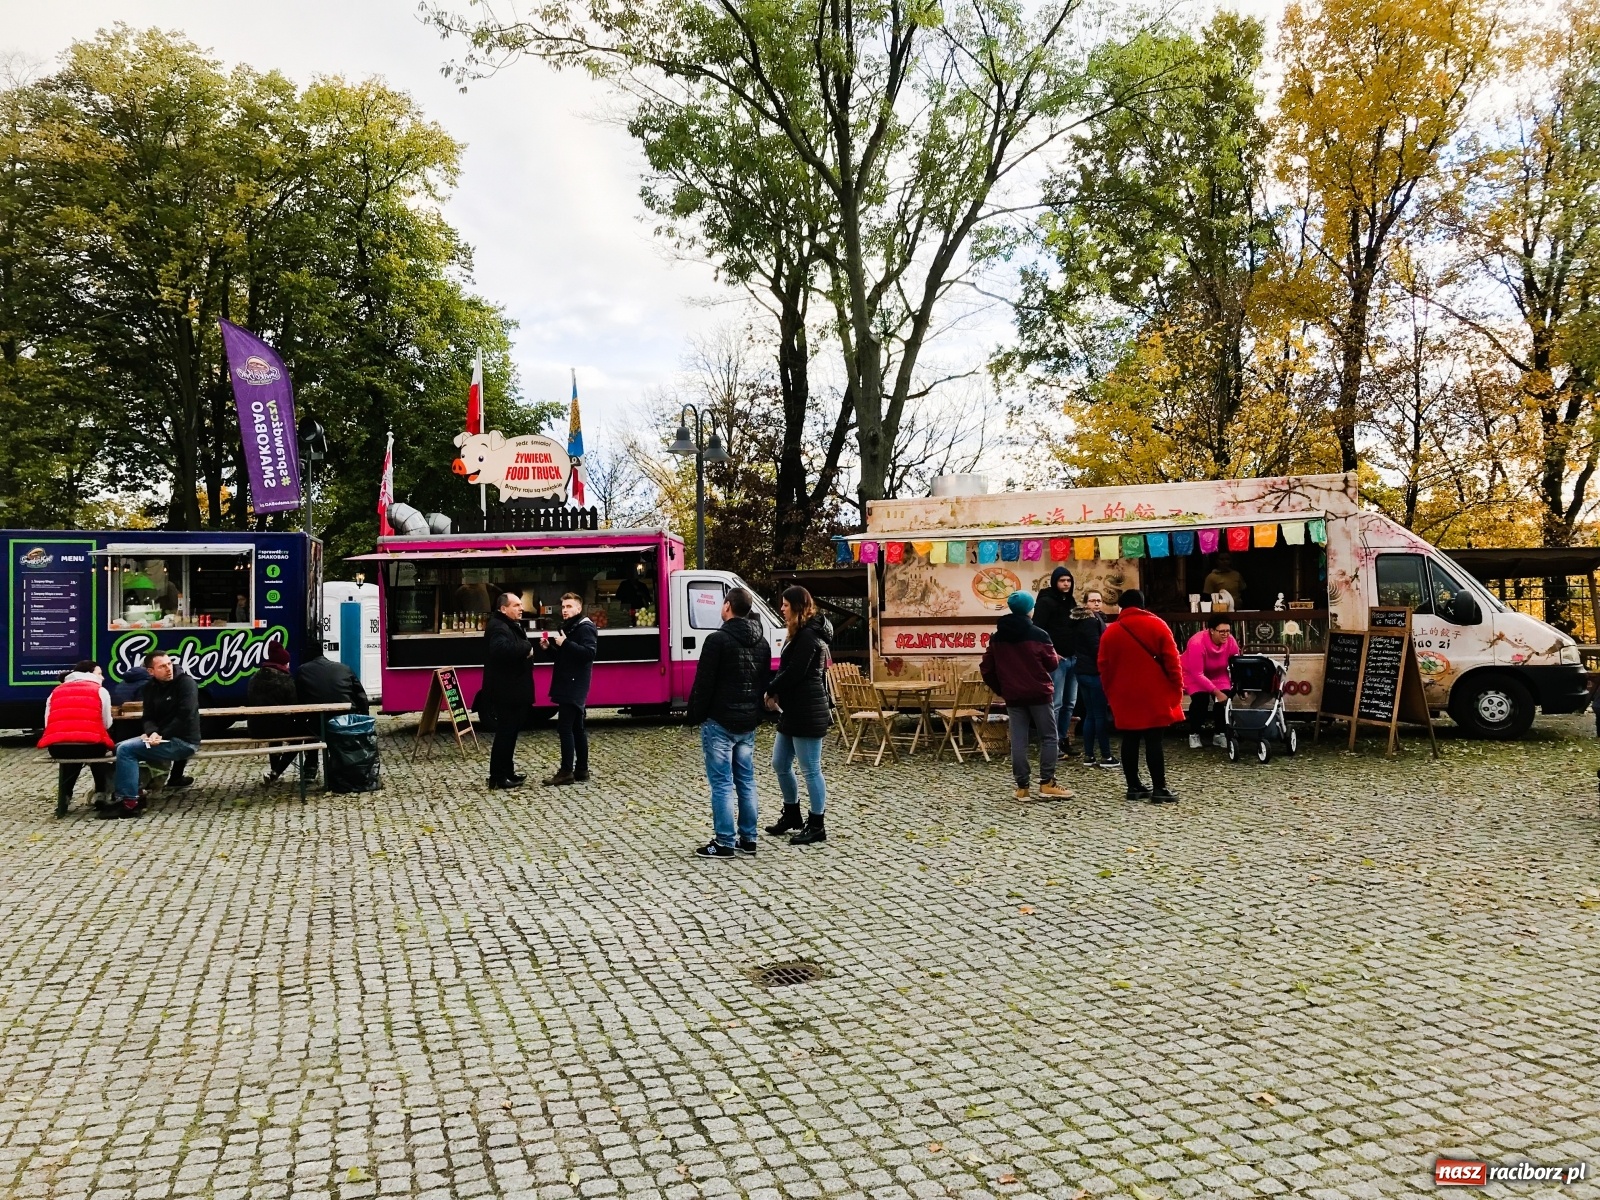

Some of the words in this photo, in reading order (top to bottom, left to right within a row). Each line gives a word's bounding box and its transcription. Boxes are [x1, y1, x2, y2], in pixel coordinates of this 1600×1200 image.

[515, 452, 553, 463] ŻYWIECKI
[505, 467, 529, 480] FOOD
[532, 466, 562, 480] TRUCK
[895, 632, 976, 649] AZJATYCKIE
[1439, 639, 1450, 649] zi
